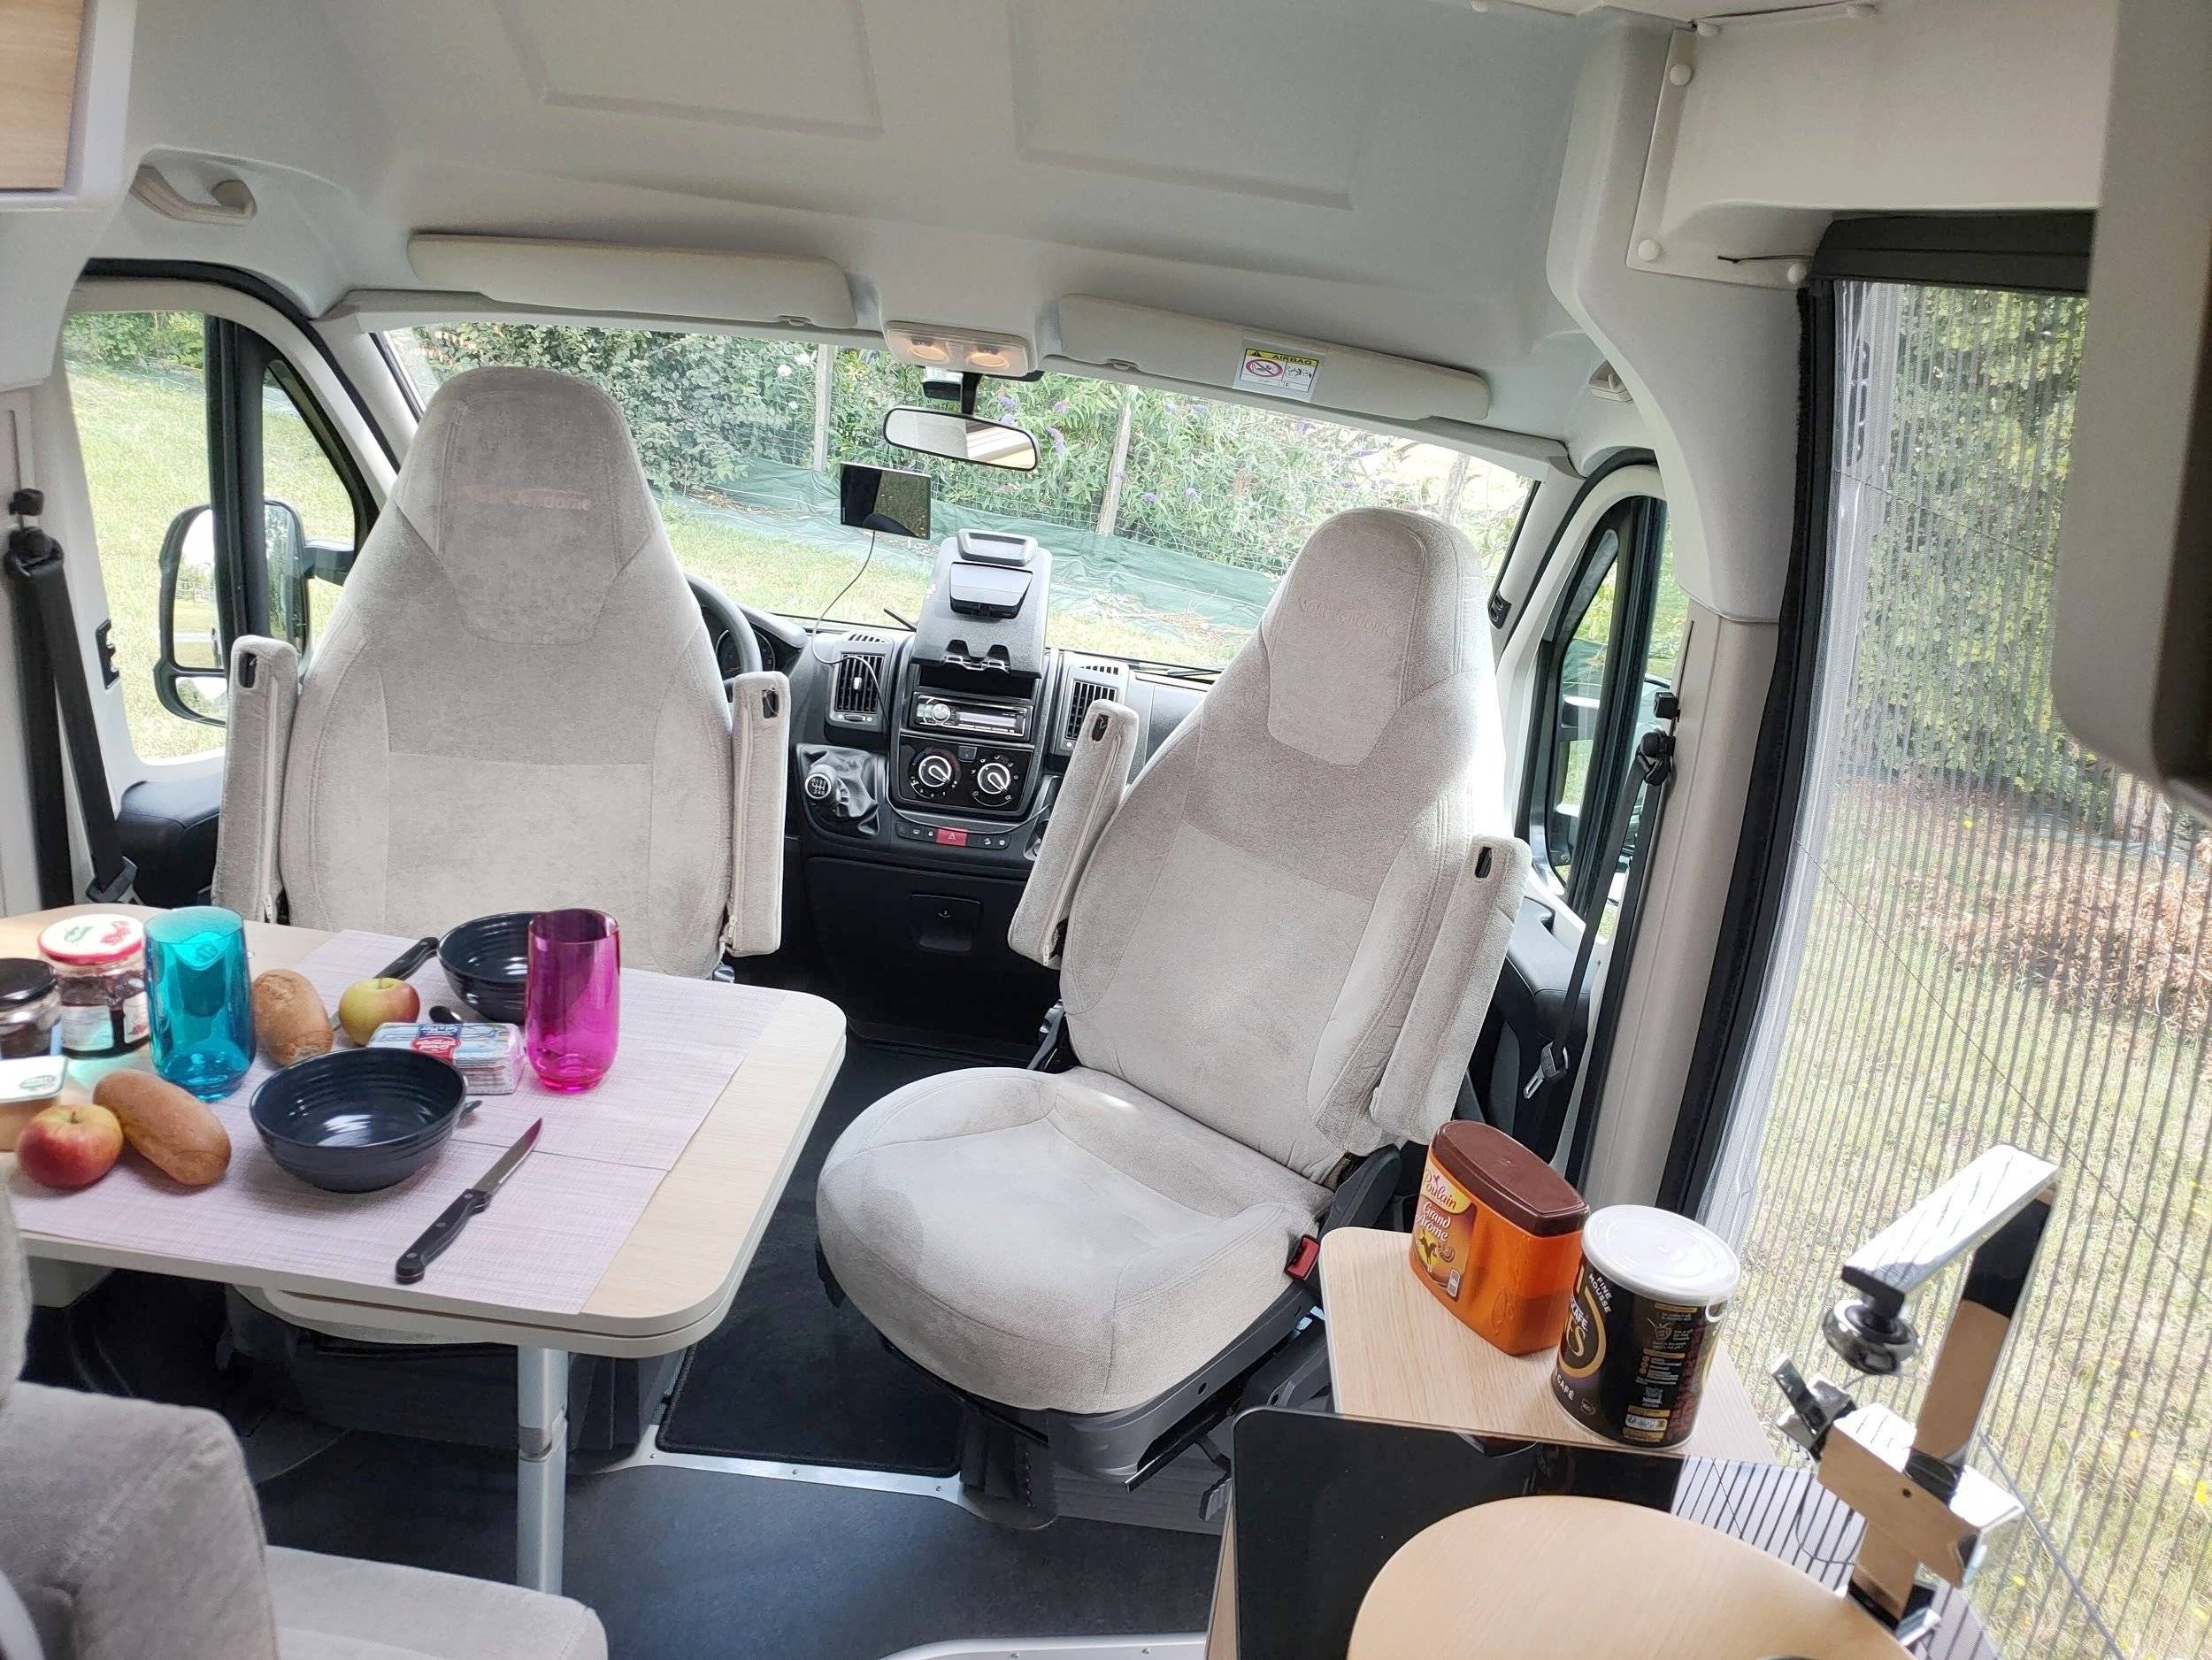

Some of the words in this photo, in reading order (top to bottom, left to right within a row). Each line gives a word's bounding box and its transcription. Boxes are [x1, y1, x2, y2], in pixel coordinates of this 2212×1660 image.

[1271, 355, 1312, 365] AIRBAG
[1423, 1169, 1457, 1210] Poulain
[1423, 1201, 1451, 1228] Grand
[1588, 1273, 1611, 1313] MOUSSE
[1596, 1276, 1612, 1300] FINE
[1556, 1373, 1575, 1401] CAFÉ
